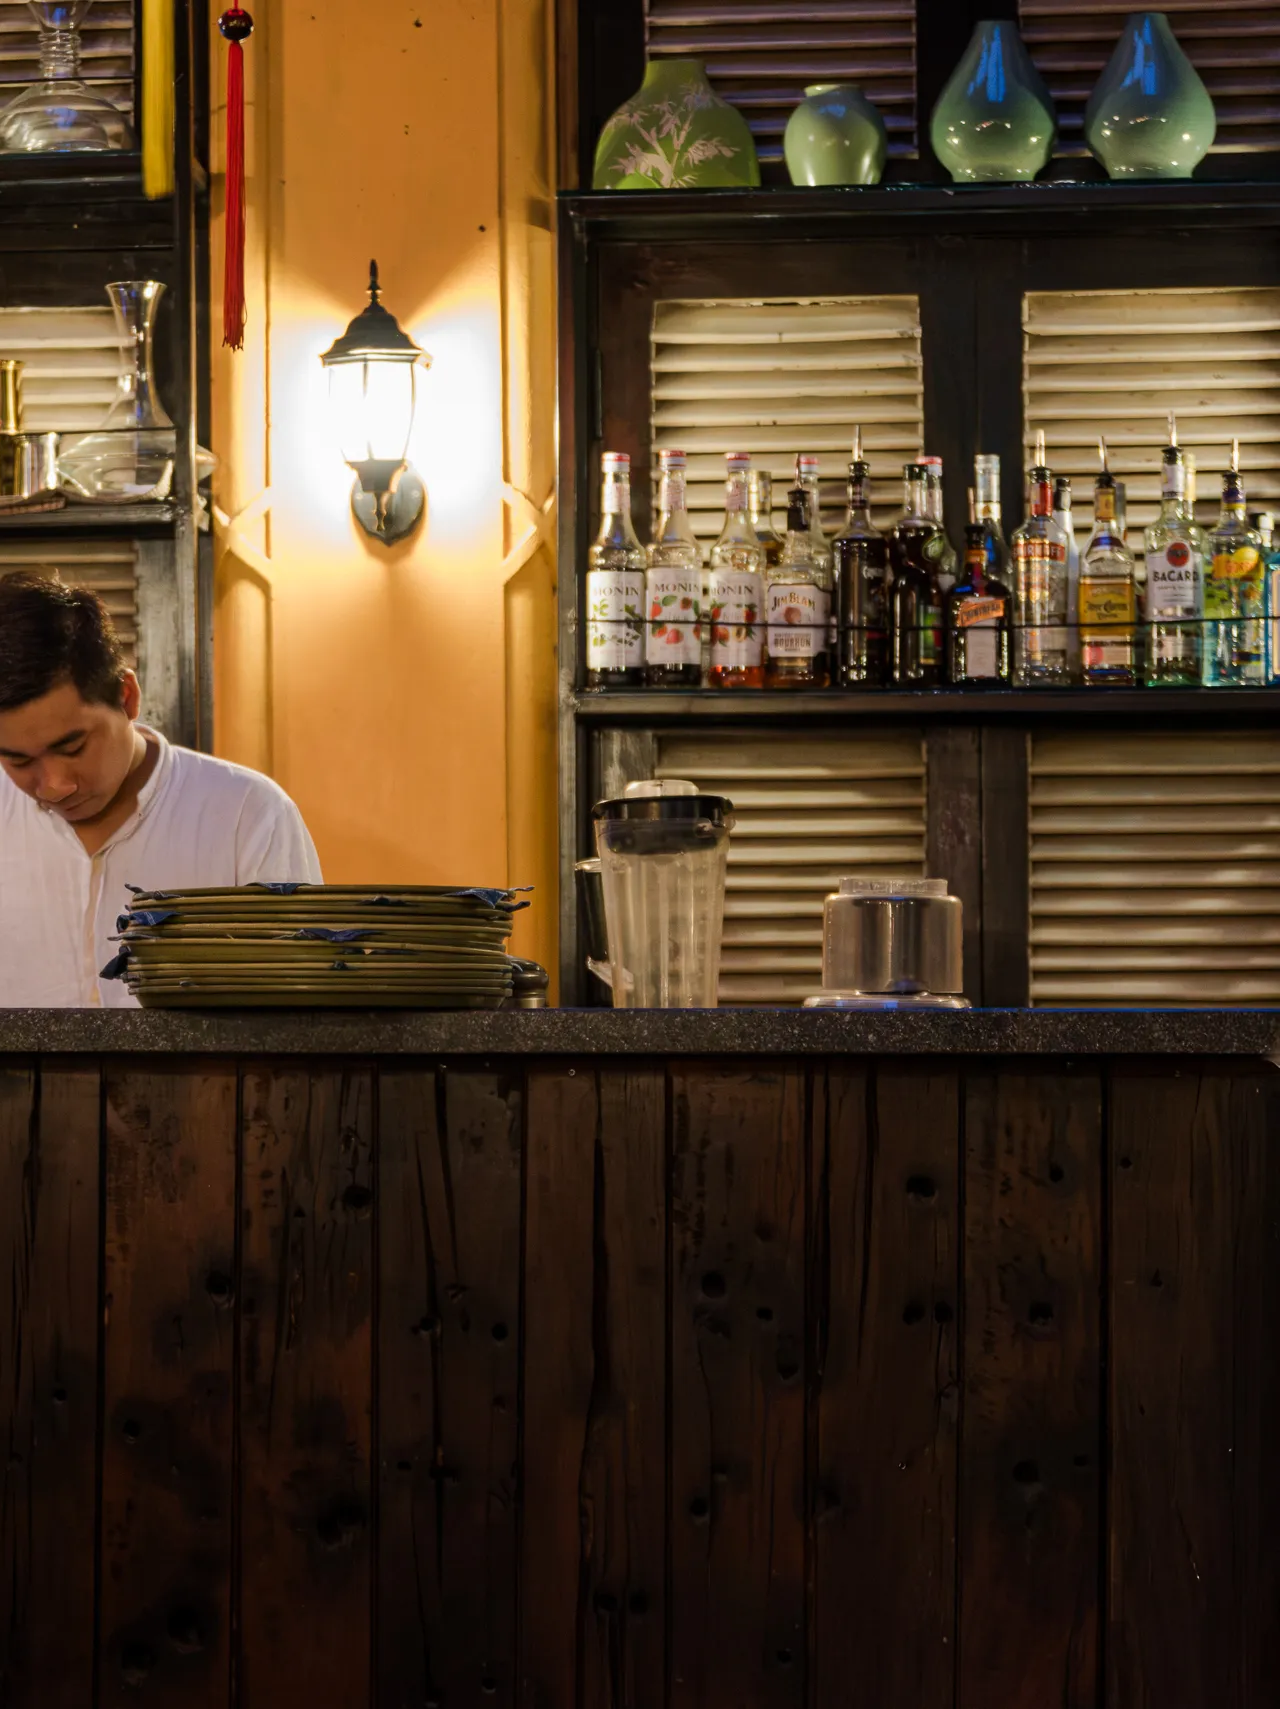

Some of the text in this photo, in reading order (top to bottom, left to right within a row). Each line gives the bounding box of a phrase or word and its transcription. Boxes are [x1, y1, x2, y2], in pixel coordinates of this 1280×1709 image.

[593, 586, 639, 597] MONIN
[655, 582, 699, 593] MONIN
[710, 585, 754, 596] MONIN
